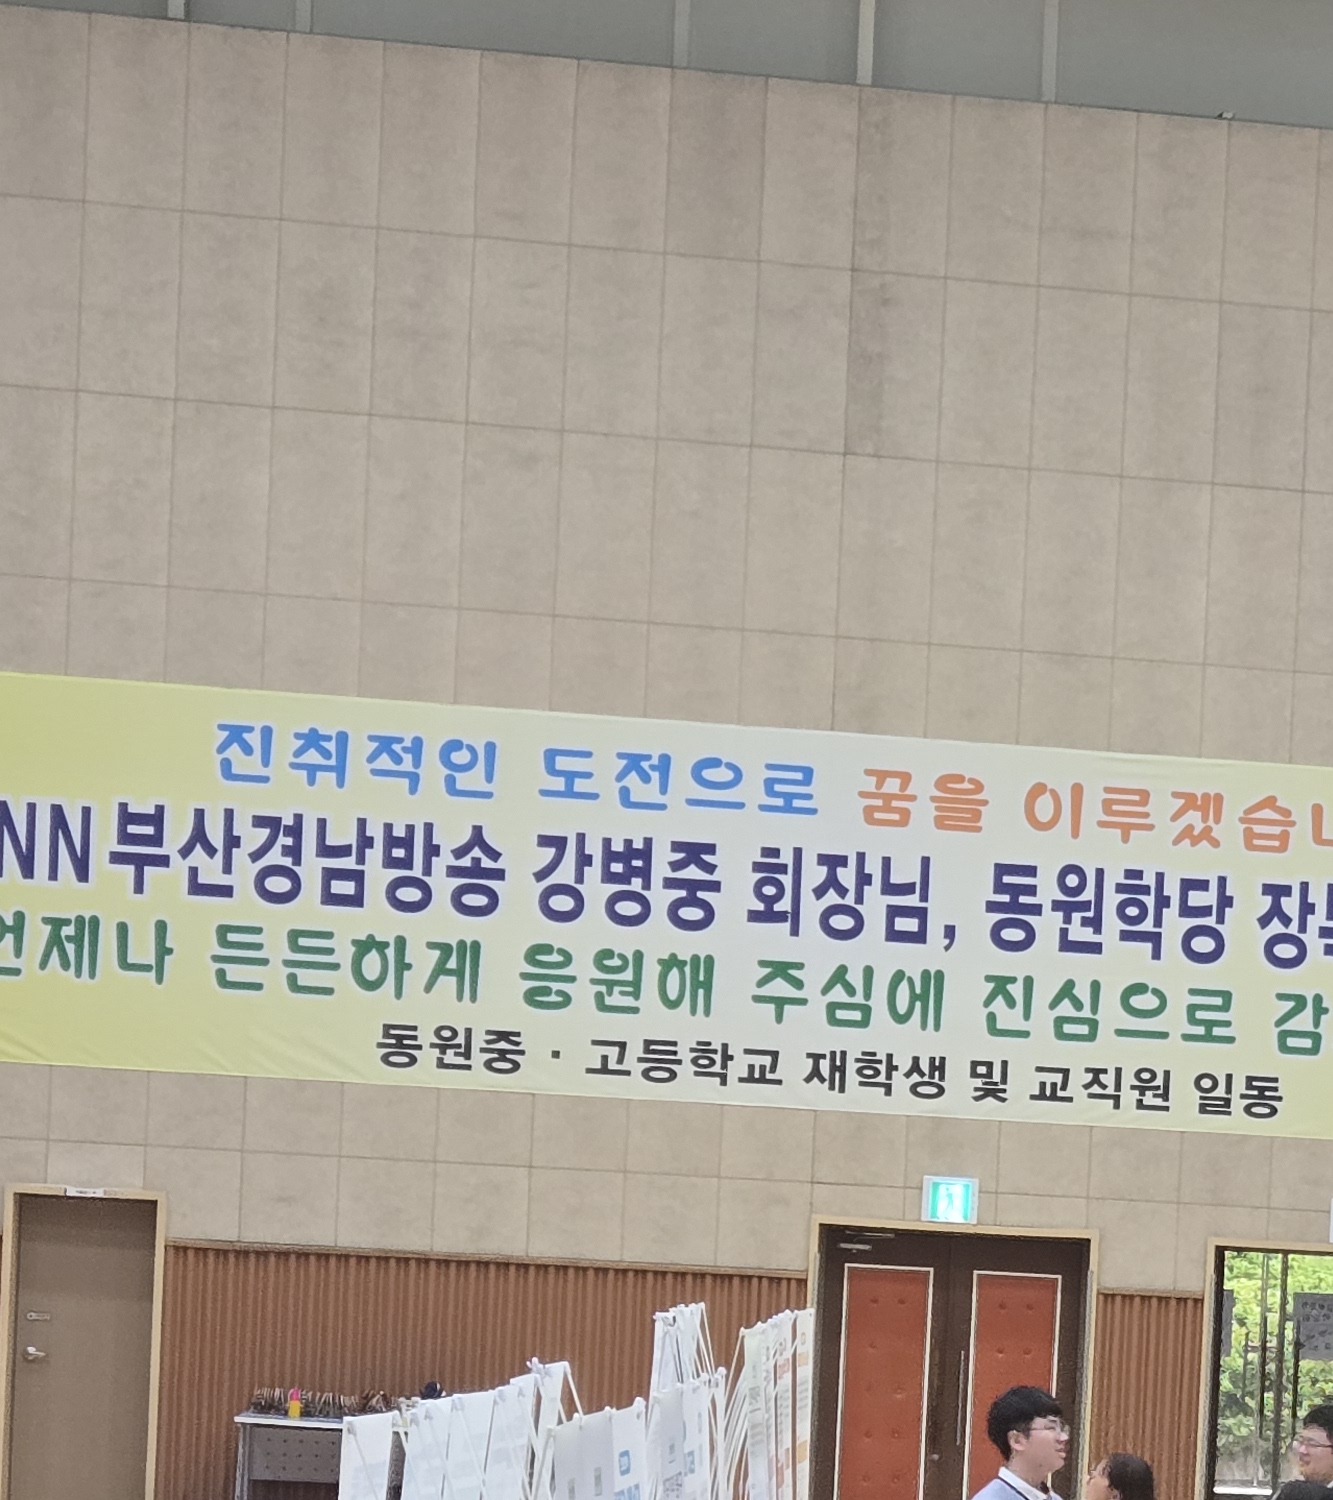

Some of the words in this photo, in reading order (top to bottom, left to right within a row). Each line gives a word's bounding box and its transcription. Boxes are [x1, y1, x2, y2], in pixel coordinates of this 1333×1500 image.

[215, 722, 498, 801] 진취적인
[537, 746, 819, 817] 도전으로
[857, 767, 989, 833] 꿈을
[108, 801, 507, 918] 부산경남방송
[532, 831, 722, 932] 강병중
[746, 846, 957, 952] 회장님,
[984, 862, 1235, 965] 동원학당
[211, 922, 482, 1004] 든든하게
[519, 941, 716, 1018] 응원해
[750, 957, 946, 1032] 주심에
[982, 972, 1236, 1047] 진심으로
[376, 1022, 527, 1075] 동원중
[584, 1037, 784, 1088] 고등학교
[802, 1049, 948, 1101] 재학생
[968, 1058, 1010, 1104] 및
[1028, 1064, 1172, 1113] 교직원
[1192, 1070, 1284, 1120] 일동
